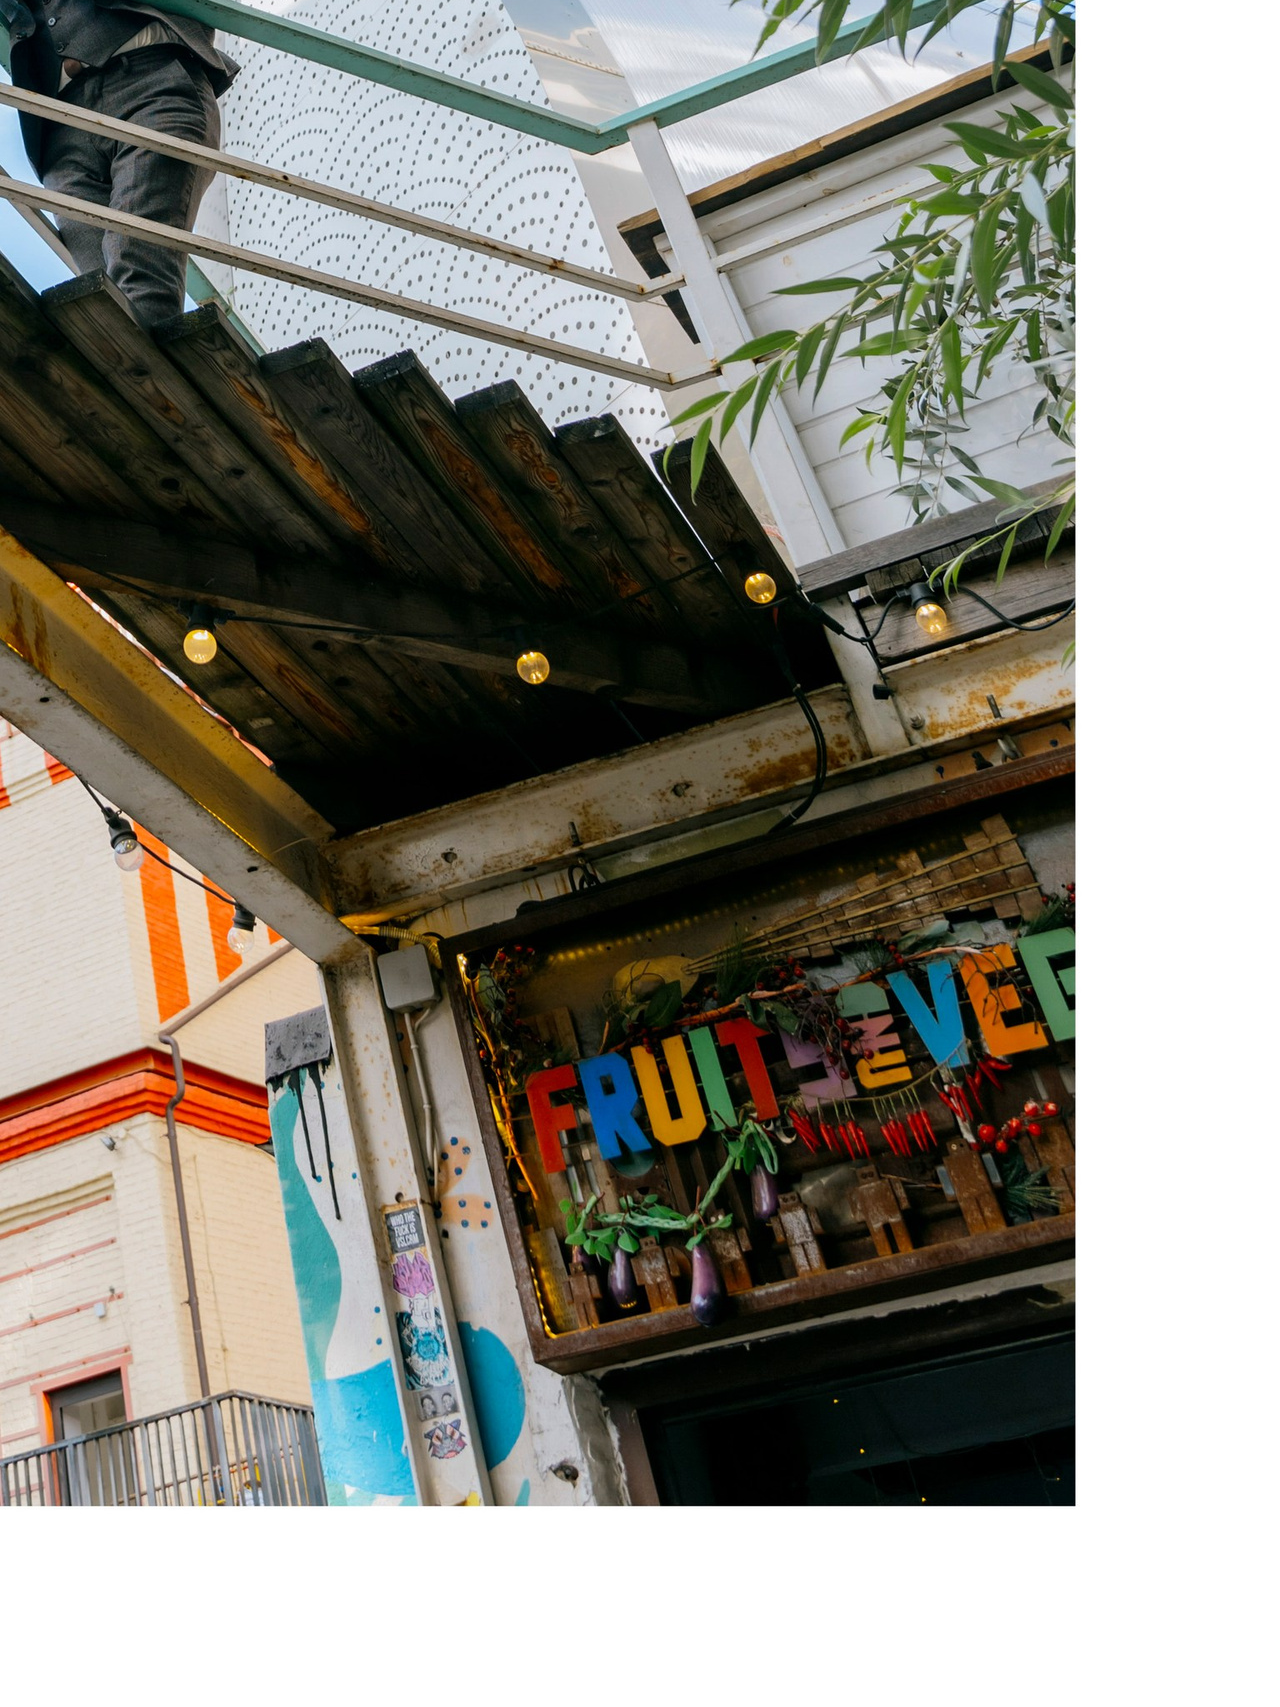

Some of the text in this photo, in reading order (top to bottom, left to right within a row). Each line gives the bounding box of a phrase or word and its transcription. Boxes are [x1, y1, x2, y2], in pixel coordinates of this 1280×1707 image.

[390, 1211, 416, 1227] WHO THE
[394, 1222, 416, 1237] FUCK IS
